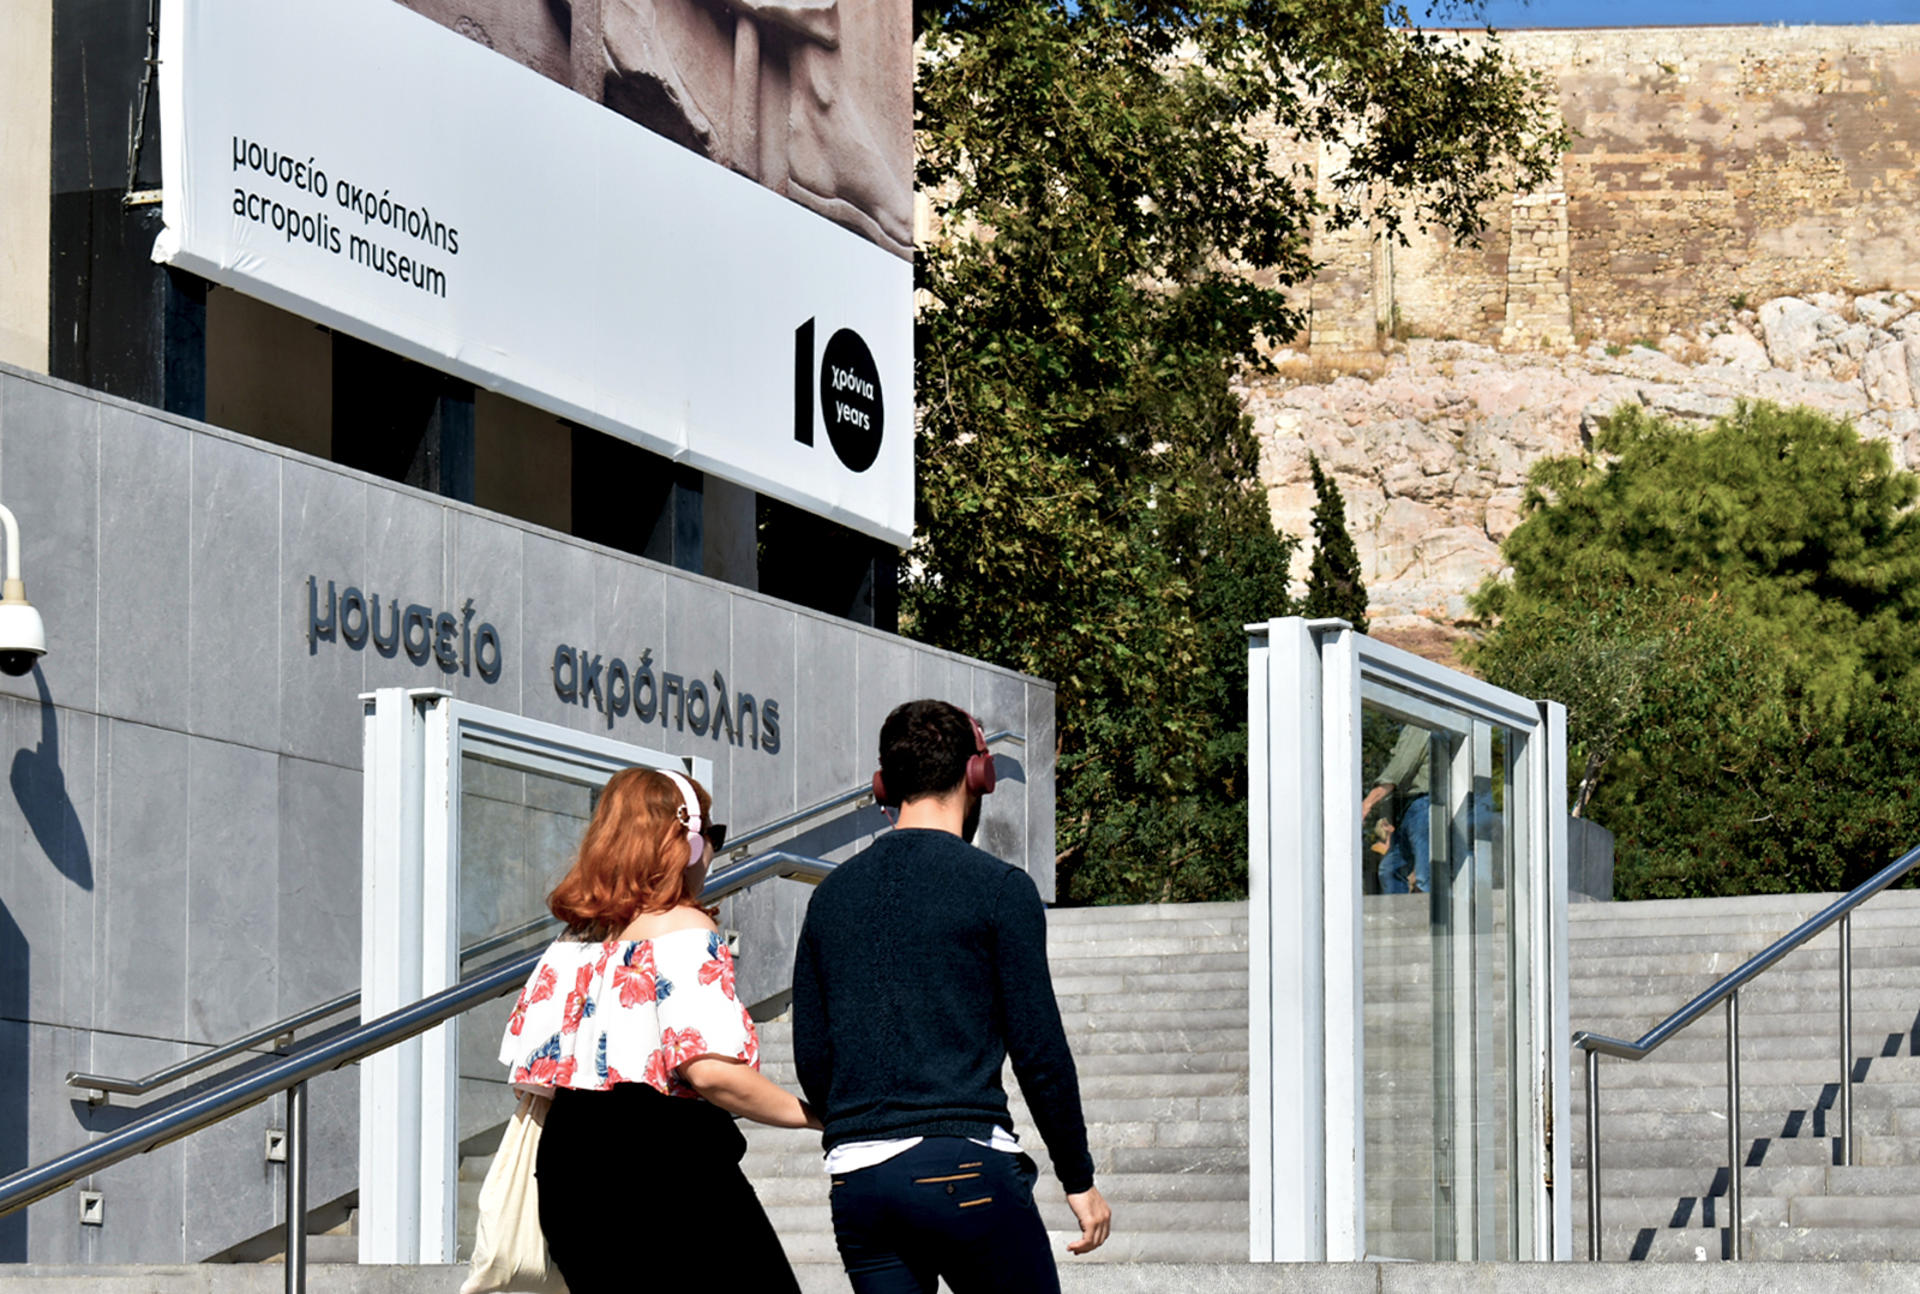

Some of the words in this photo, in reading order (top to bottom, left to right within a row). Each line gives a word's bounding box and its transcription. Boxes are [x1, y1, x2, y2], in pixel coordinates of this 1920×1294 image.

[232, 136, 328, 198] μουσείο
[336, 179, 459, 255] ακρόπολης
[233, 188, 342, 254] acropolis
[350, 234, 446, 298] museum
[831, 365, 874, 401] χρόνια
[836, 400, 871, 431] years
[306, 575, 501, 684] μουσείο
[553, 643, 780, 755] ακρόπολης
